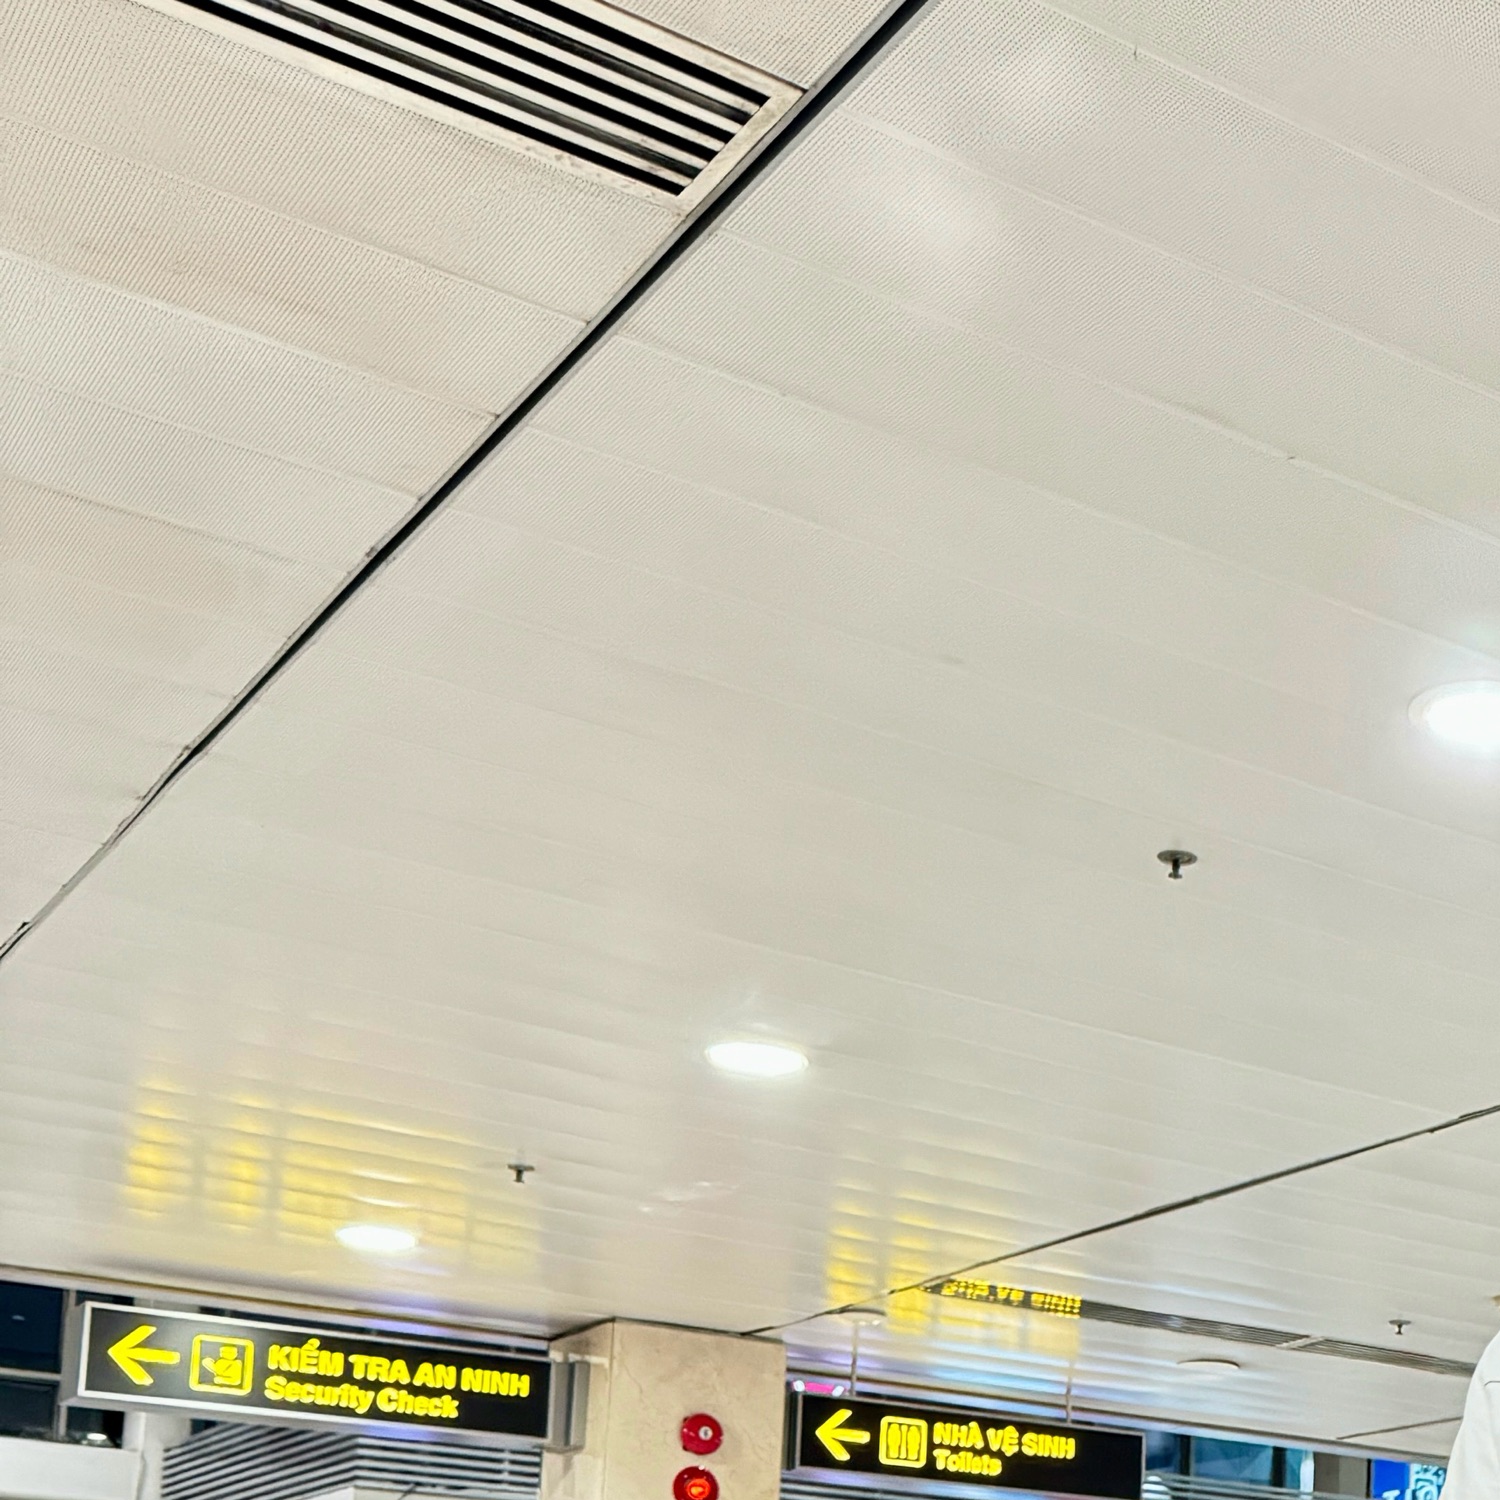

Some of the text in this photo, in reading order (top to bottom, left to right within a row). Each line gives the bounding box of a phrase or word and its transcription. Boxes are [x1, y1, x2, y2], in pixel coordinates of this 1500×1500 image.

[348, 1354, 411, 1385] TRA
[413, 1362, 457, 1390] AN
[460, 1367, 531, 1398] NINH
[264, 1375, 459, 1419] Security Check
[933, 1421, 1075, 1460] NHÀ VỆ SINH
[933, 1448, 1002, 1476] Toilets
